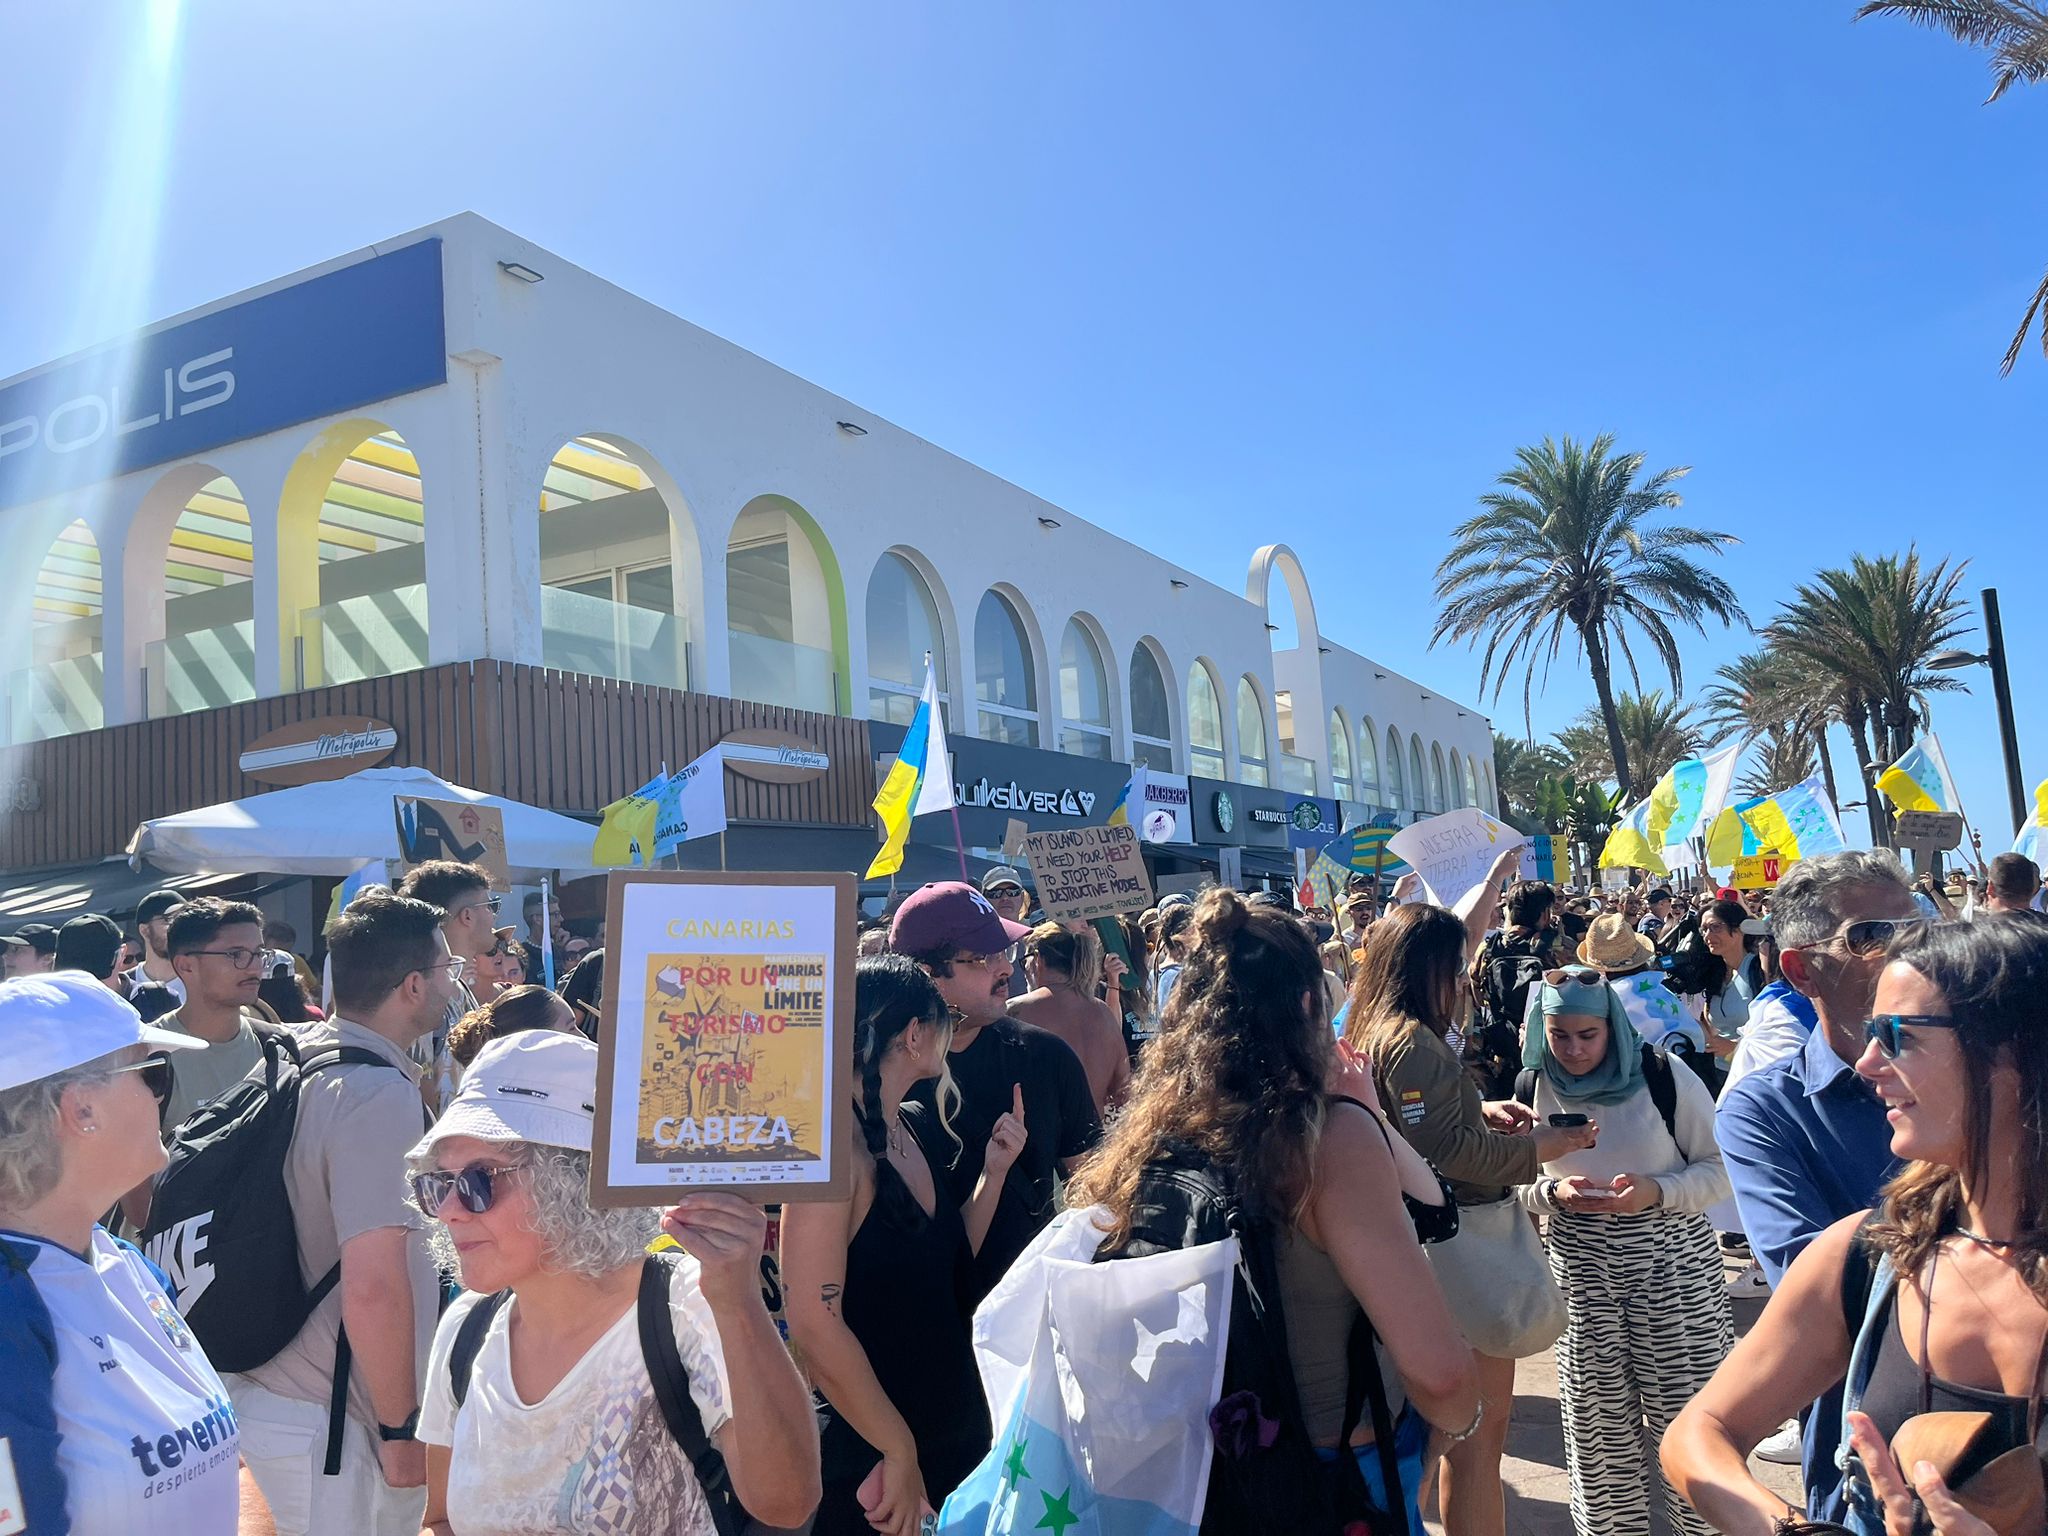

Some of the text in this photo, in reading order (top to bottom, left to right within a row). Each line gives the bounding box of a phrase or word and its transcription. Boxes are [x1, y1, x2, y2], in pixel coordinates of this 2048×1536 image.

[1255, 809, 1287, 823] STARBUCKS
[1027, 836, 1044, 852] MY
[1034, 844, 1132, 869] I NEED YOUR HELP
[1040, 874, 1056, 886] TO
[1061, 867, 1090, 886] STOP
[1046, 876, 1145, 903] DESTRUCTIVE MODEL
[665, 918, 795, 939] CANARIAS
[680, 966, 779, 987] POR UN
[764, 964, 823, 976] CANARIAS
[804, 977, 823, 991] UN
[764, 988, 823, 1010] LÍMITE
[668, 1014, 785, 1035] TURISMO
[696, 1063, 754, 1084] CON
[653, 1117, 793, 1146] CABEZA
[131, 1394, 239, 1477] tenerif
